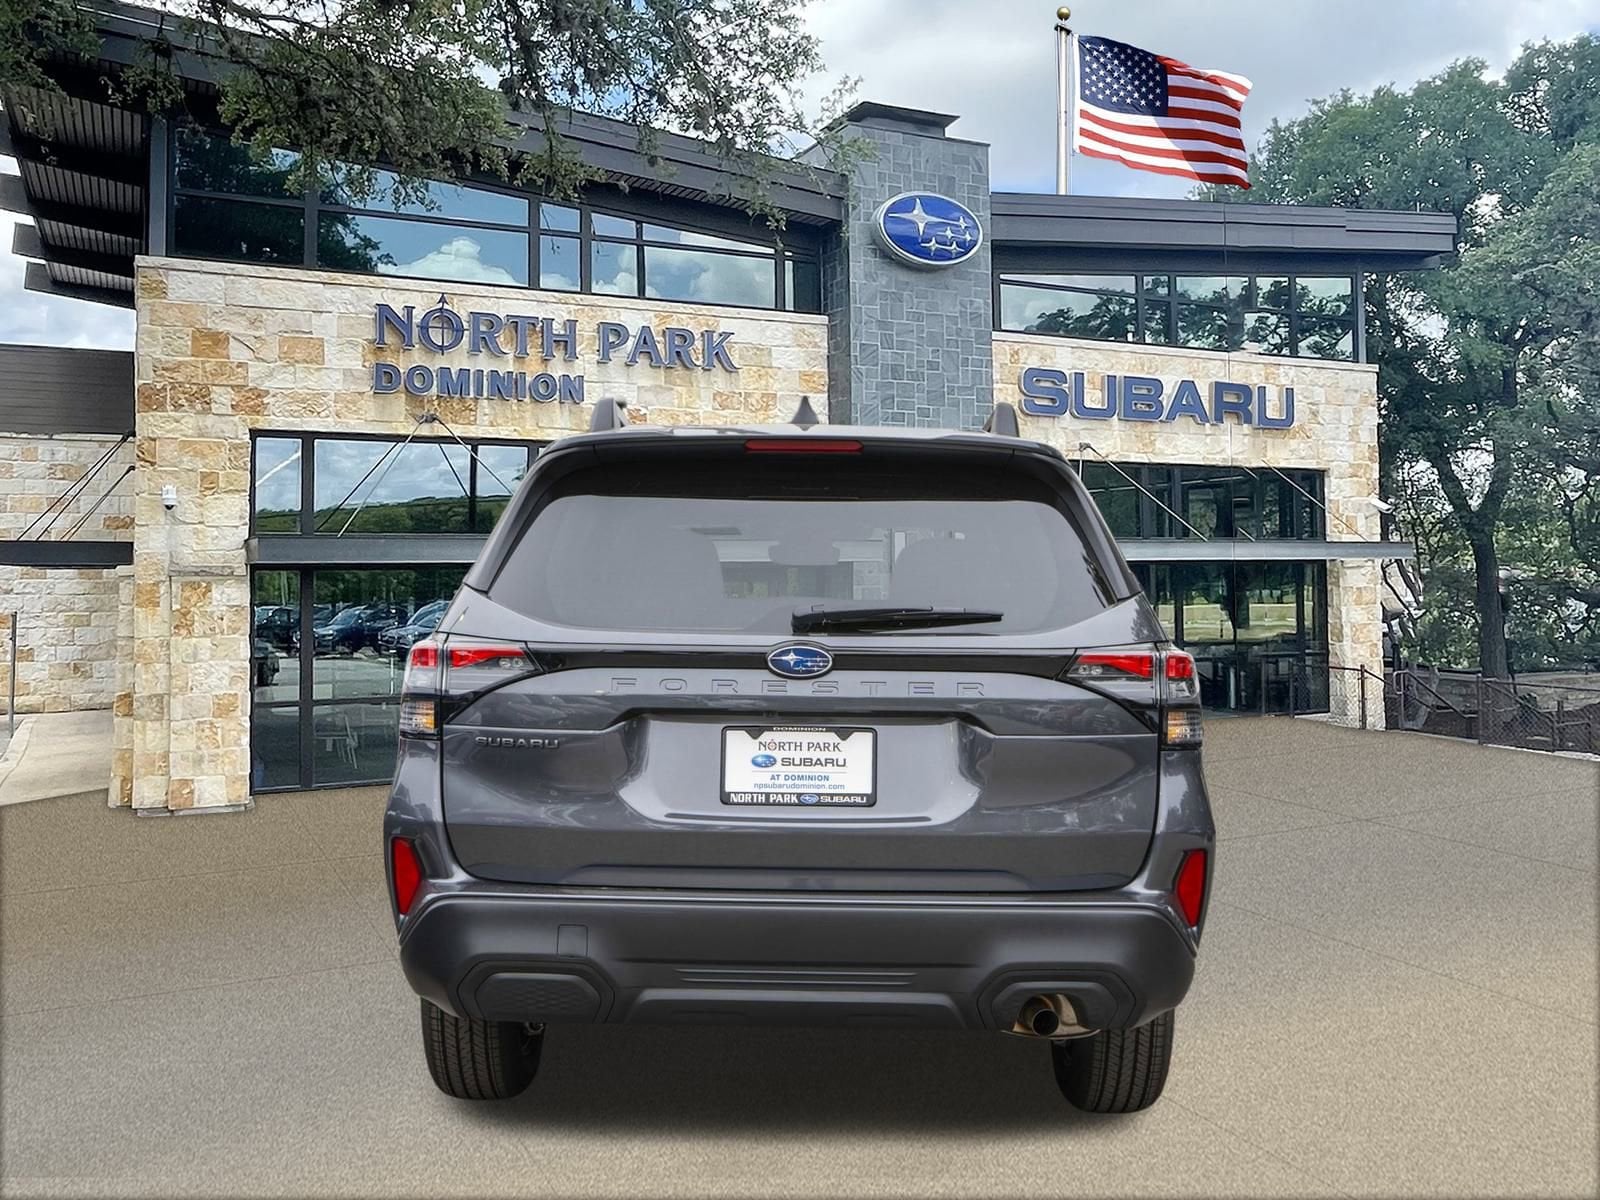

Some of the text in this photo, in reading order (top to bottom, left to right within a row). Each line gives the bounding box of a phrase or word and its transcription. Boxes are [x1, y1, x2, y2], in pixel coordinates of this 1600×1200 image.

[375, 296, 742, 373] NORTH PARK
[372, 362, 585, 404] DOMINION
[1018, 367, 1295, 429] SUBARU
[610, 677, 986, 697] FORESTER
[475, 736, 560, 750] SUBARU
[758, 739, 842, 752] NORTH PARK
[781, 757, 847, 768] SUBARU
[770, 774, 830, 782] AT DOMINION
[753, 782, 846, 791] npsubarudominion.com
[730, 793, 867, 804] NORTH PARK SUBARU
